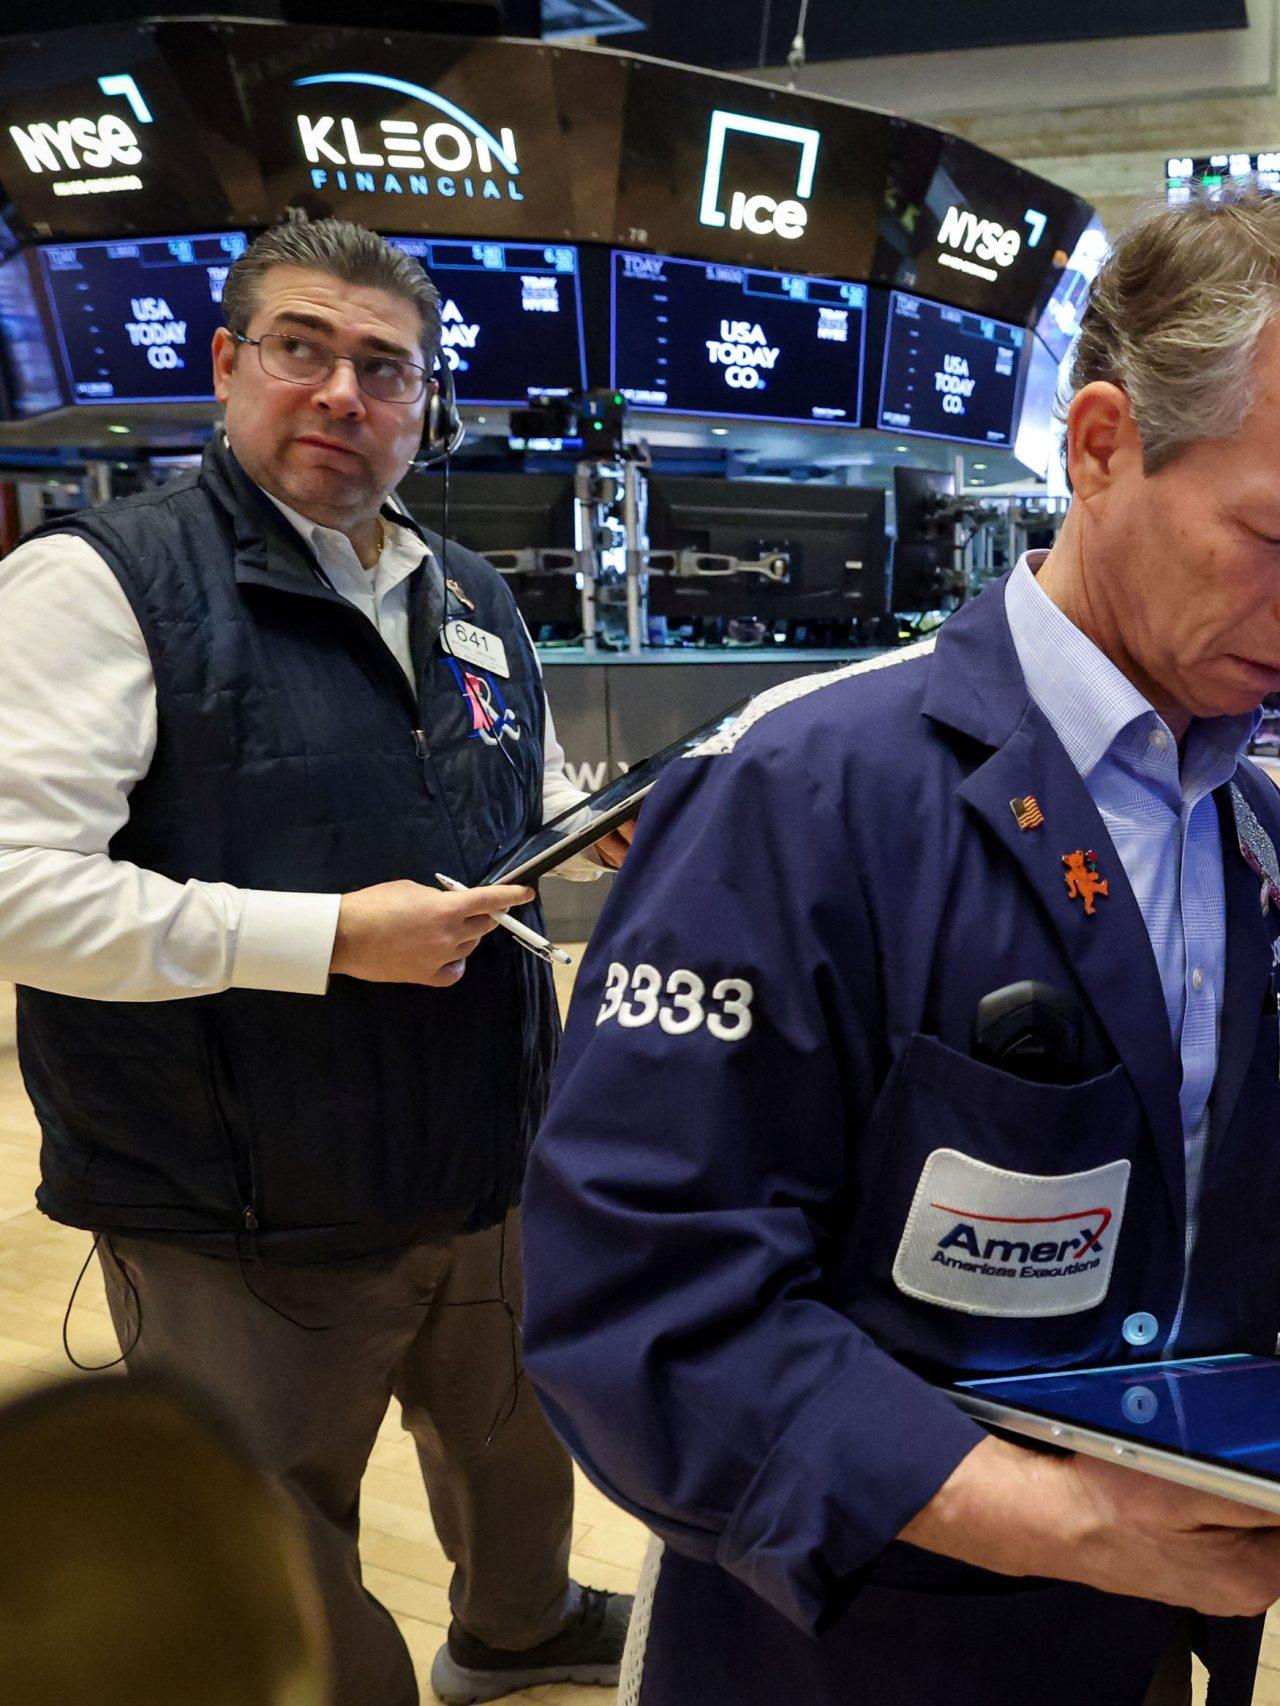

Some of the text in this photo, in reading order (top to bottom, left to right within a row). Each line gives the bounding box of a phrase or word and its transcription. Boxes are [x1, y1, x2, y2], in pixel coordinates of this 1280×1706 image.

[297, 114, 520, 174] KLEON
[310, 168, 524, 201] FINANCIAL
[130, 297, 174, 321] USA
[125, 321, 187, 346] TODAY
[721, 319, 767, 345] USA
[706, 340, 780, 369] TODAY
[943, 354, 969, 377] USA
[935, 372, 975, 397] TODAY
[455, 624, 489, 652] 641
[595, 962, 754, 1041] 3333
[937, 1223, 1104, 1263] AmerX
[931, 1251, 1101, 1279] Americas Executions
